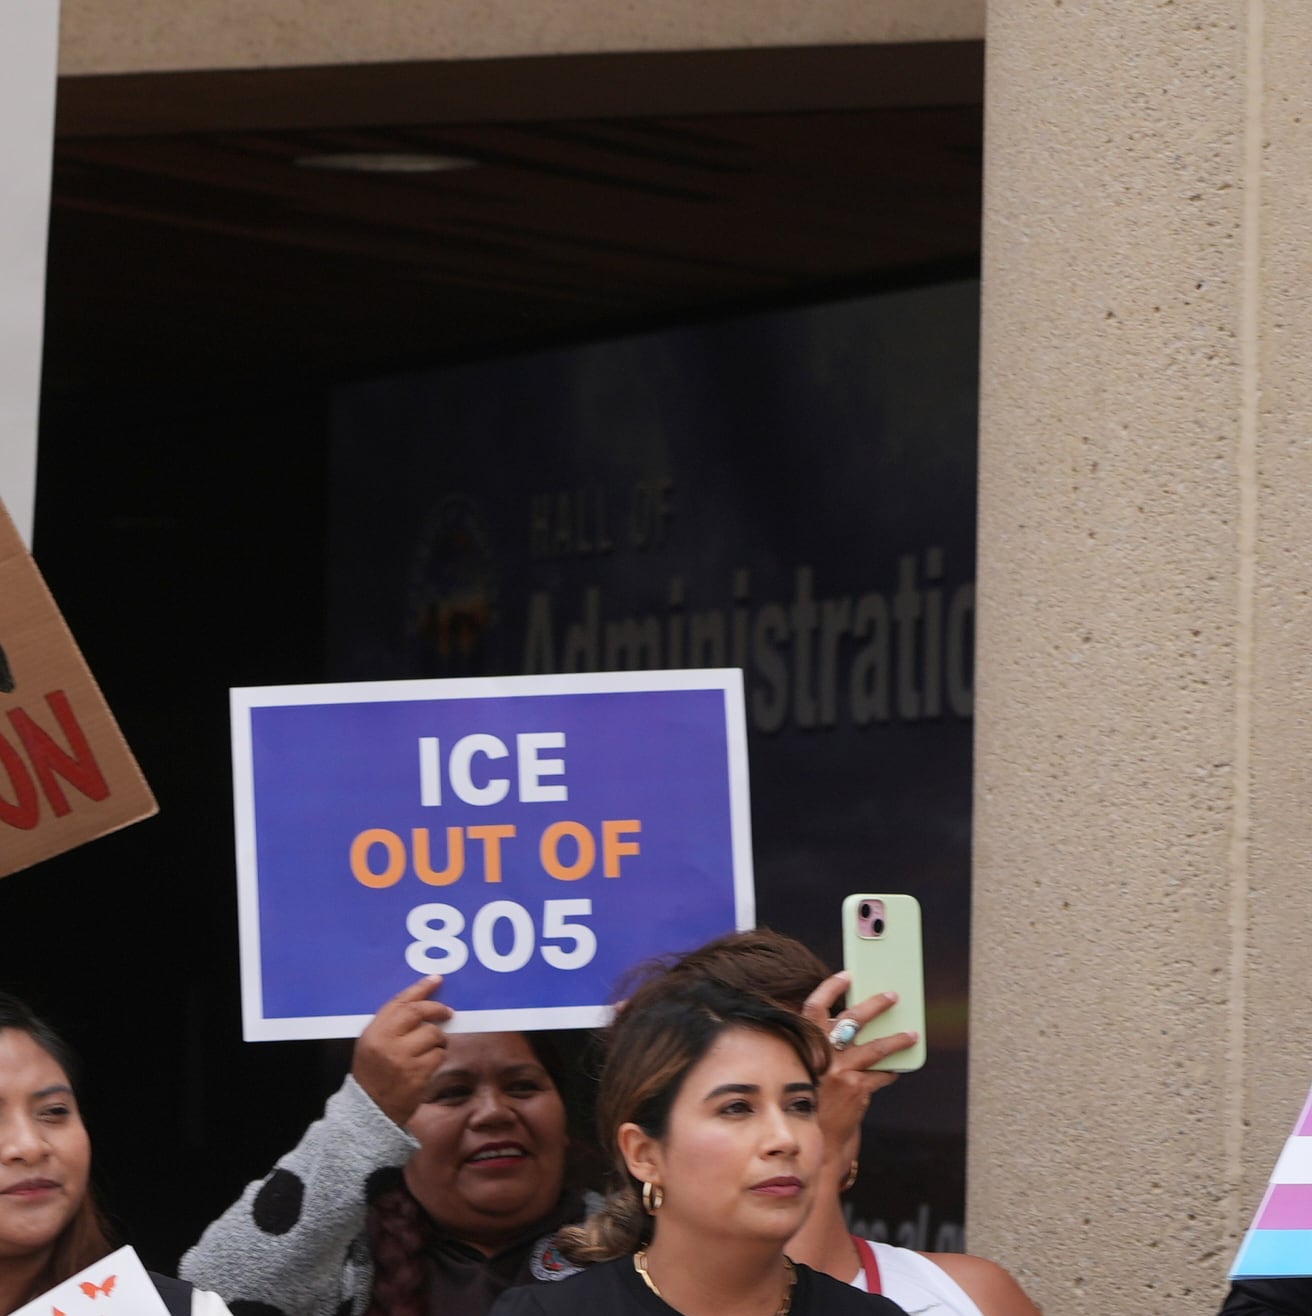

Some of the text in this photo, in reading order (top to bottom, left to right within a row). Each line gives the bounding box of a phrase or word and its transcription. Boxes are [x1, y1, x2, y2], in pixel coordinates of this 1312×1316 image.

[419, 732, 568, 807] ICE
[349, 819, 642, 889] OUT OF
[404, 898, 598, 977] 805
